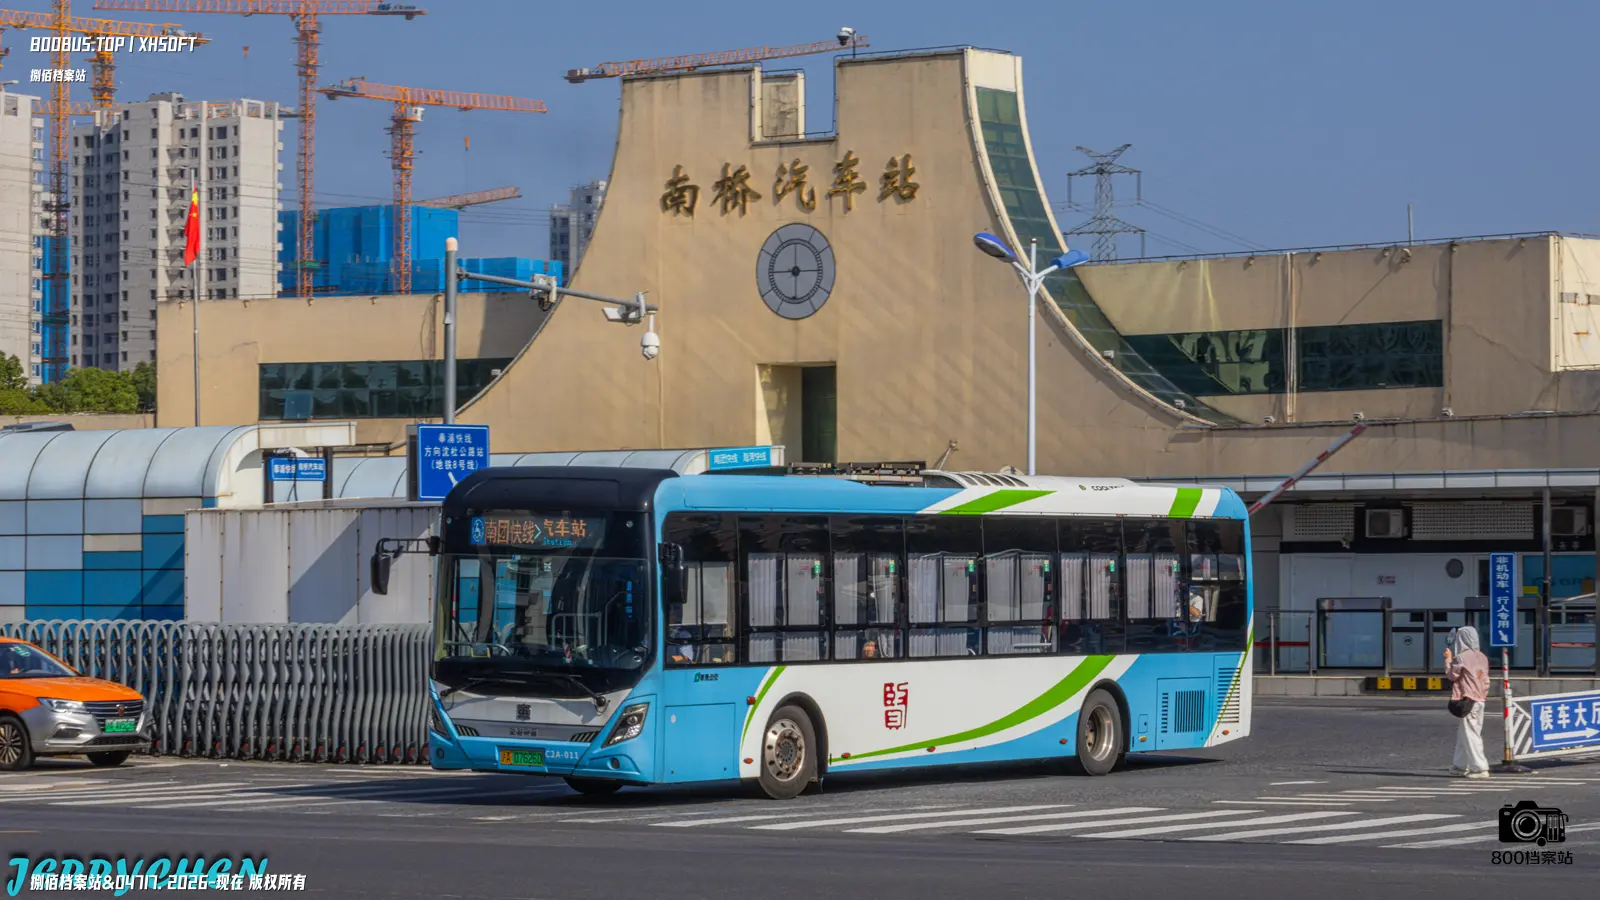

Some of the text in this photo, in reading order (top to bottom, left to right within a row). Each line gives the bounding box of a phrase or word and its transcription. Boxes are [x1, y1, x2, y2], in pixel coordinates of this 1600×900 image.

[659, 149, 921, 220] 南桥汽车站
[1496, 556, 1510, 629] 非机动车、行人专用
[1540, 701, 1600, 732] 候车大厅
[545, 750, 579, 759] C2A-011
